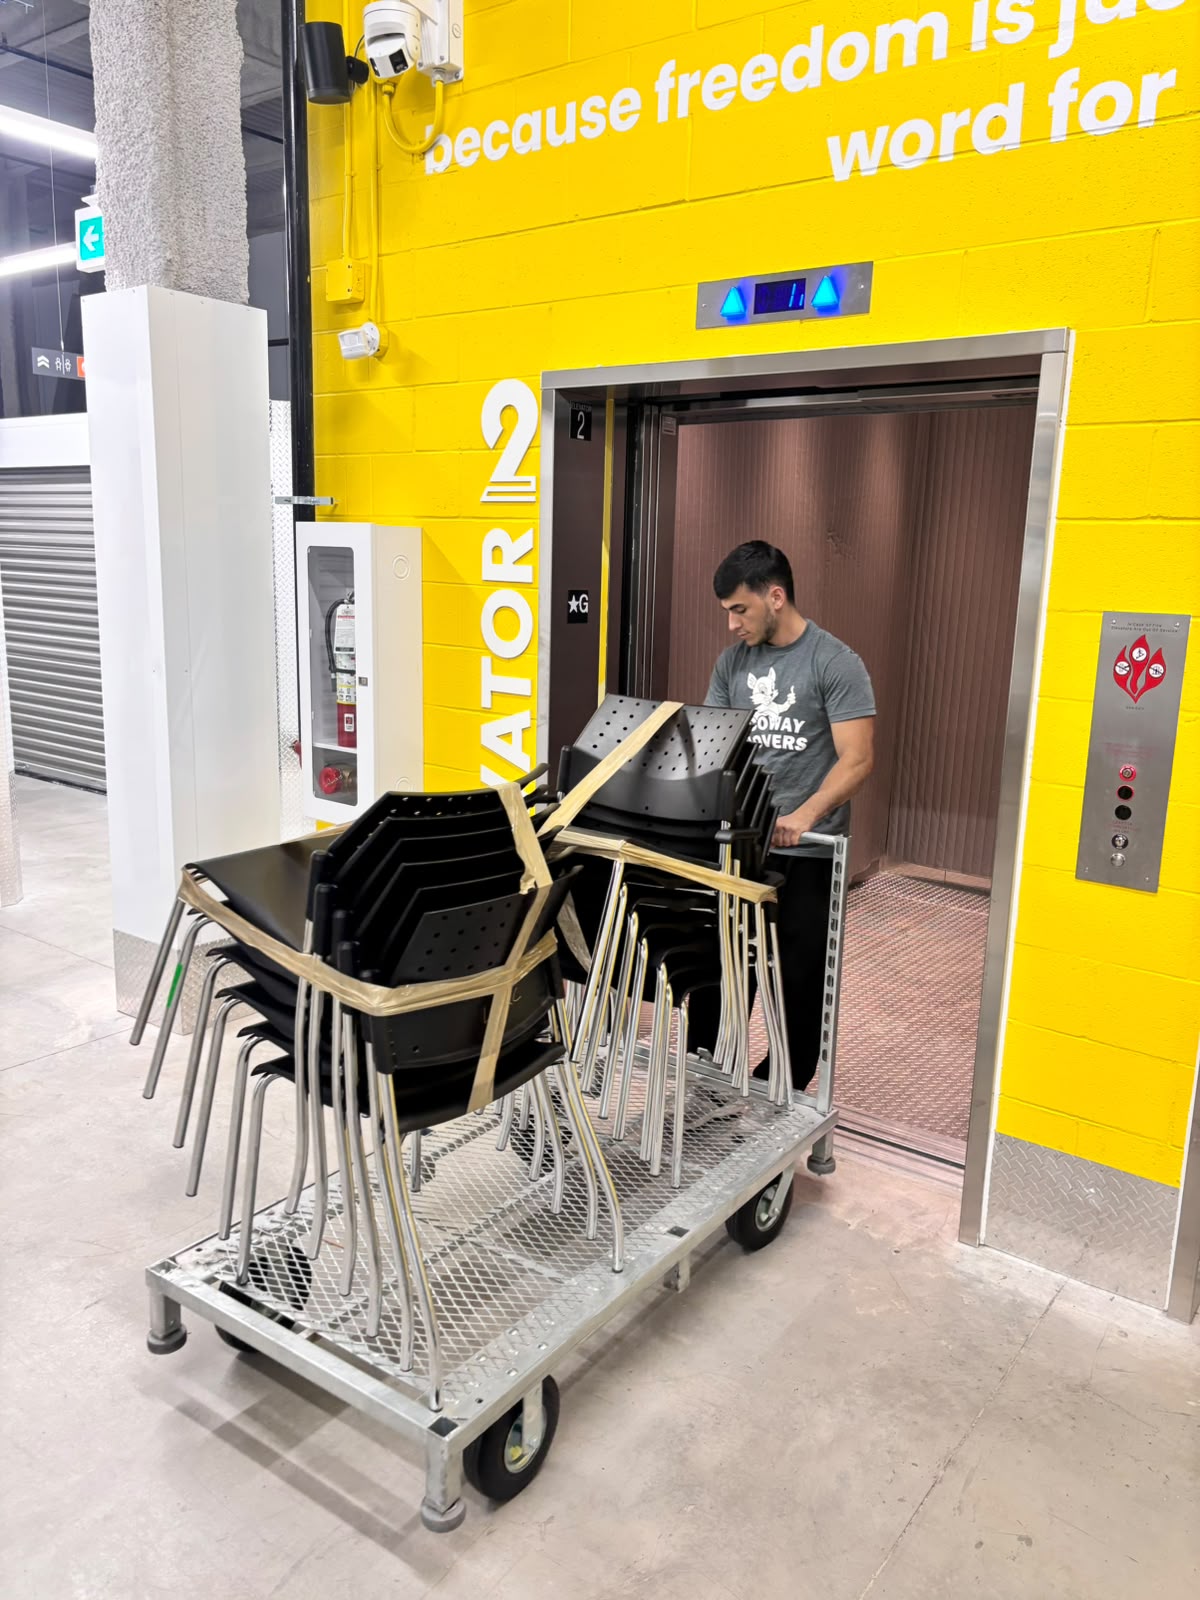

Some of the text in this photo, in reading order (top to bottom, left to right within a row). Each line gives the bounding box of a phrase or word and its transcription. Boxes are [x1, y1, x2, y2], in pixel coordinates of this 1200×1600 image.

[425, 87, 642, 174] because
[654, 11, 949, 123] freedom
[970, 0, 1035, 52] is
[826, 67, 1177, 182] word for
[577, 411, 585, 440] 2
[479, 378, 539, 798] ATOR 2
[746, 733, 808, 751] OVERS
[751, 715, 806, 734] OWAY
